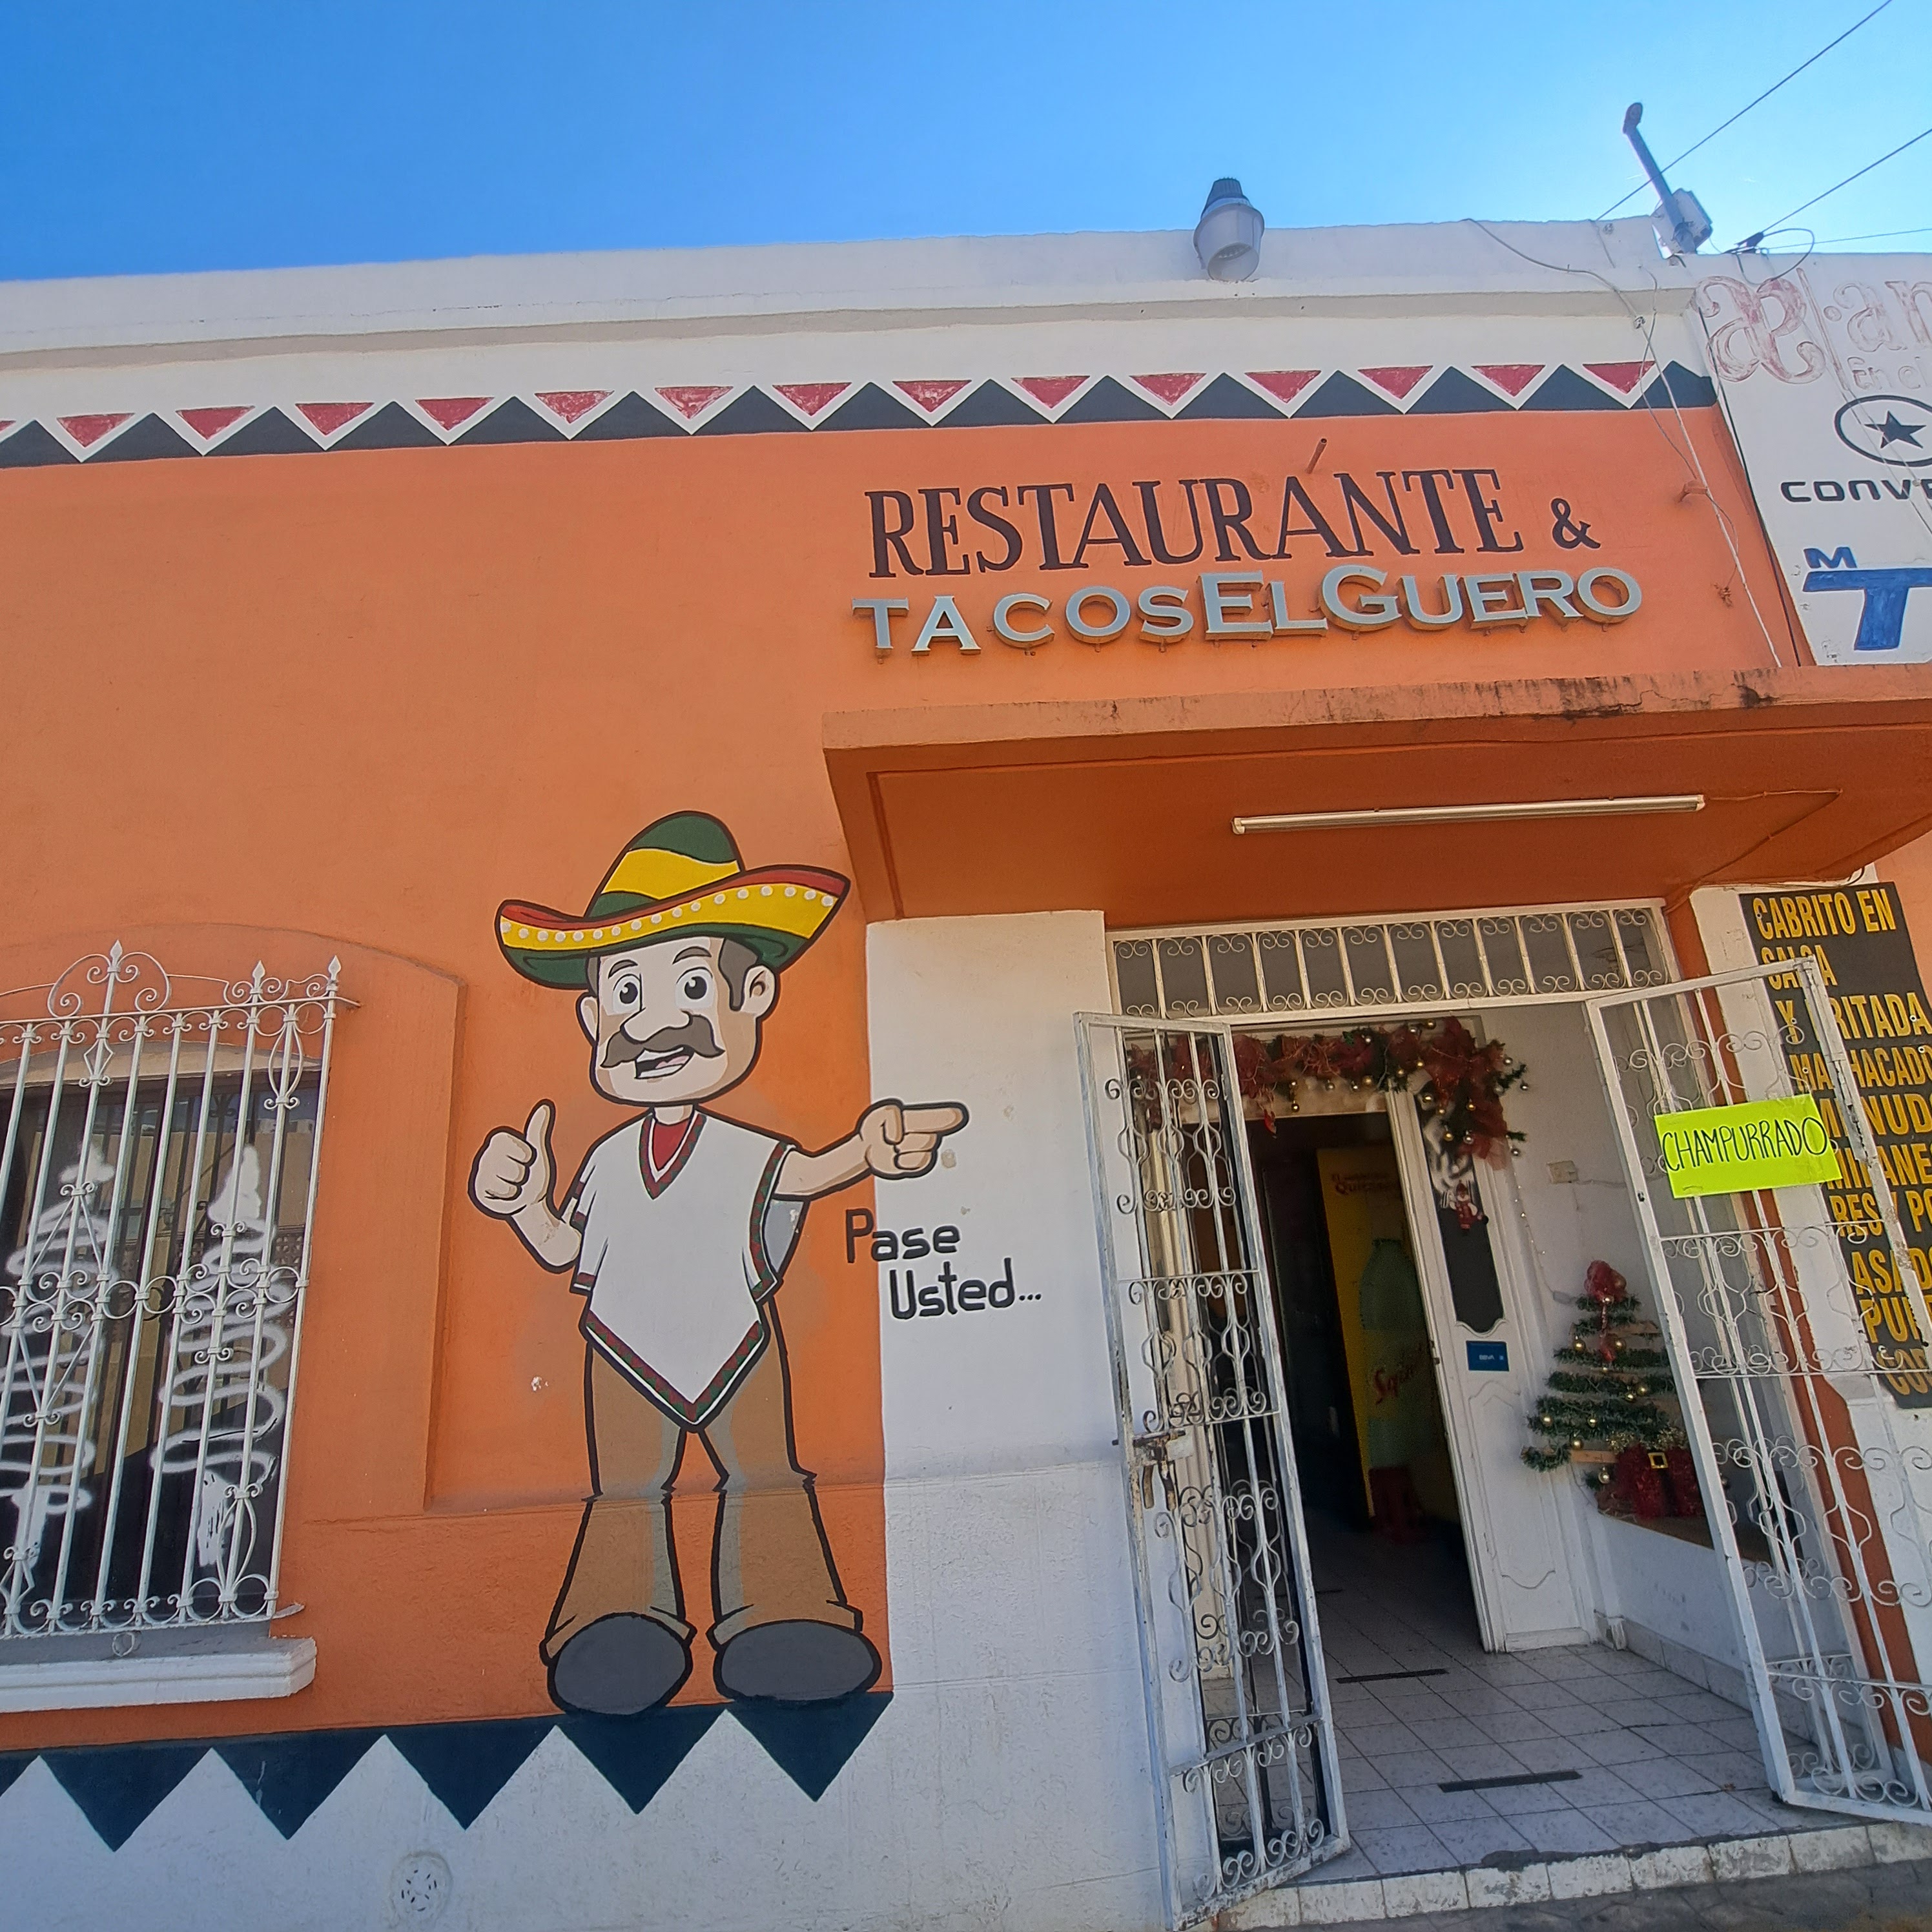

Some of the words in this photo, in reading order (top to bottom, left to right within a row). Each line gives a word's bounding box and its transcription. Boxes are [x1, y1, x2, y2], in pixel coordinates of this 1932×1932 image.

[865, 469, 1523, 577] RESTAURANTE
[1550, 498, 1601, 550] &
[852, 586, 1194, 655] TACOS
[1752, 892, 1856, 940] CABRITO
[1855, 889, 1896, 932] EN
[1761, 945, 1838, 990] SAA
[1775, 1000, 1798, 1043] Y
[1805, 992, 1932, 1042] RITADA
[1789, 1045, 1932, 1091] MAHACAD
[1819, 1093, 1932, 1138] MNUD
[1662, 1117, 1827, 1171] CHAMPURRADO
[1827, 1143, 1932, 1190] MIANE
[845, 1208, 960, 1264] Pase
[1829, 1193, 1883, 1237] RES
[1851, 1246, 1932, 1295] ASD
